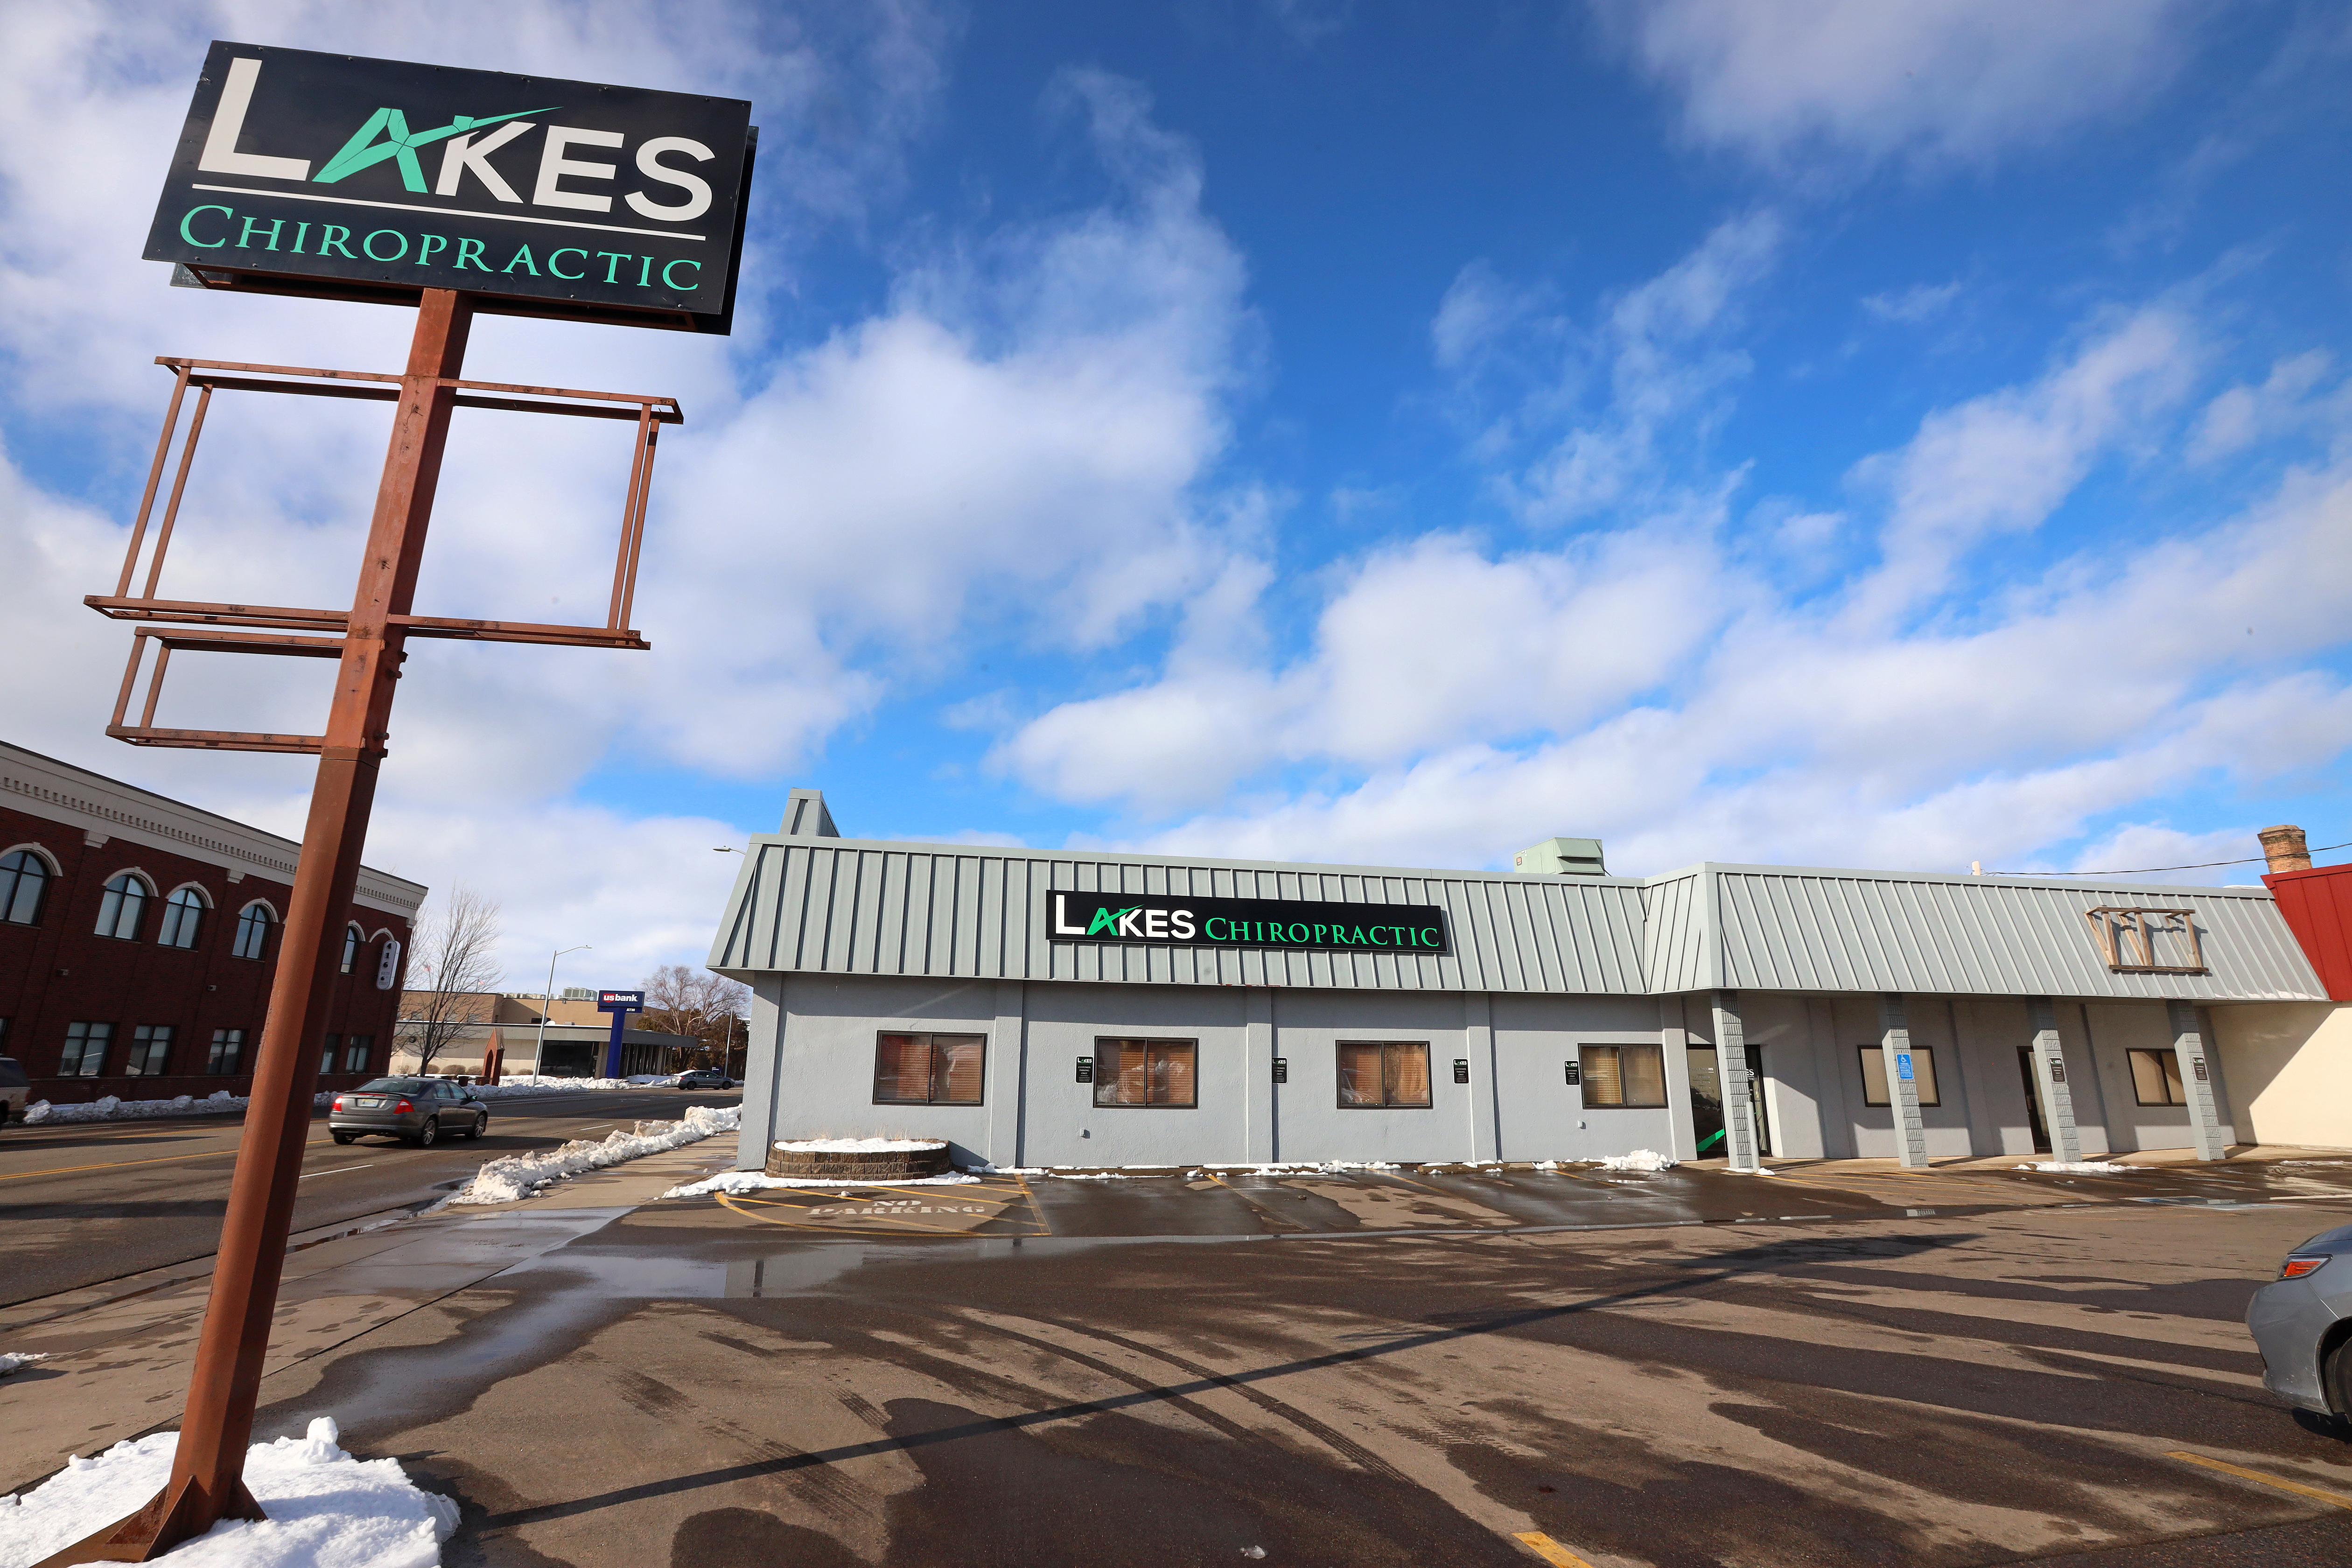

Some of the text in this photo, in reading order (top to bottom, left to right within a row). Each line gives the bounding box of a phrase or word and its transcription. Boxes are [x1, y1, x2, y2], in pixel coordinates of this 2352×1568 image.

[197, 57, 715, 222] LAKES
[180, 205, 701, 290] CHIROPRACTIC
[1055, 895, 1439, 947] LAKES CHIROPRACTIC
[806, 1206, 986, 1215] PARKING
